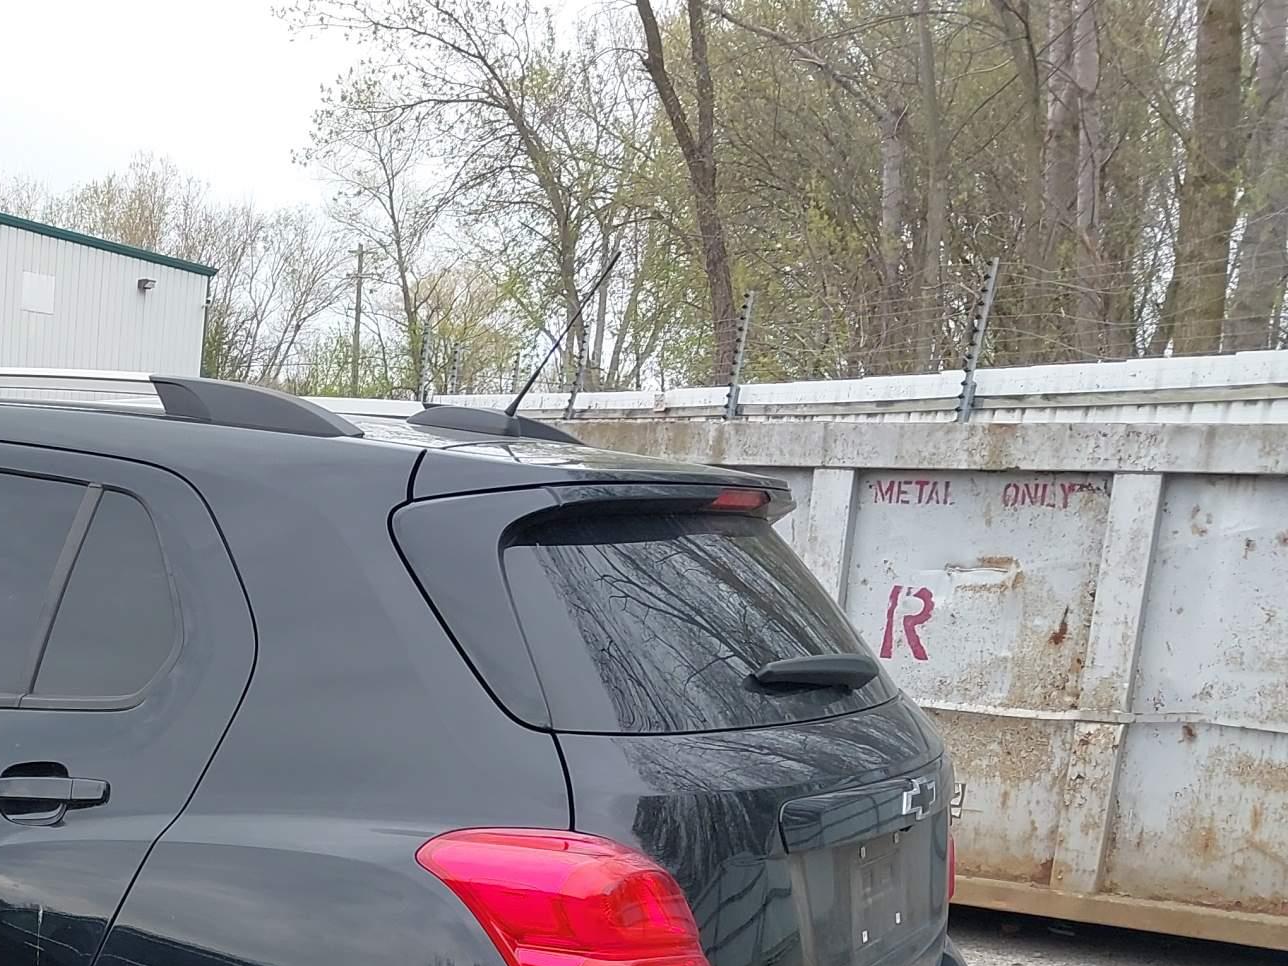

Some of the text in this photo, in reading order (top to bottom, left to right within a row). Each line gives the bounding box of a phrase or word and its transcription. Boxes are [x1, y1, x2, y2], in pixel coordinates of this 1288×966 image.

[873, 480, 1077, 509] METAL ONLY
[880, 585, 935, 660] R
